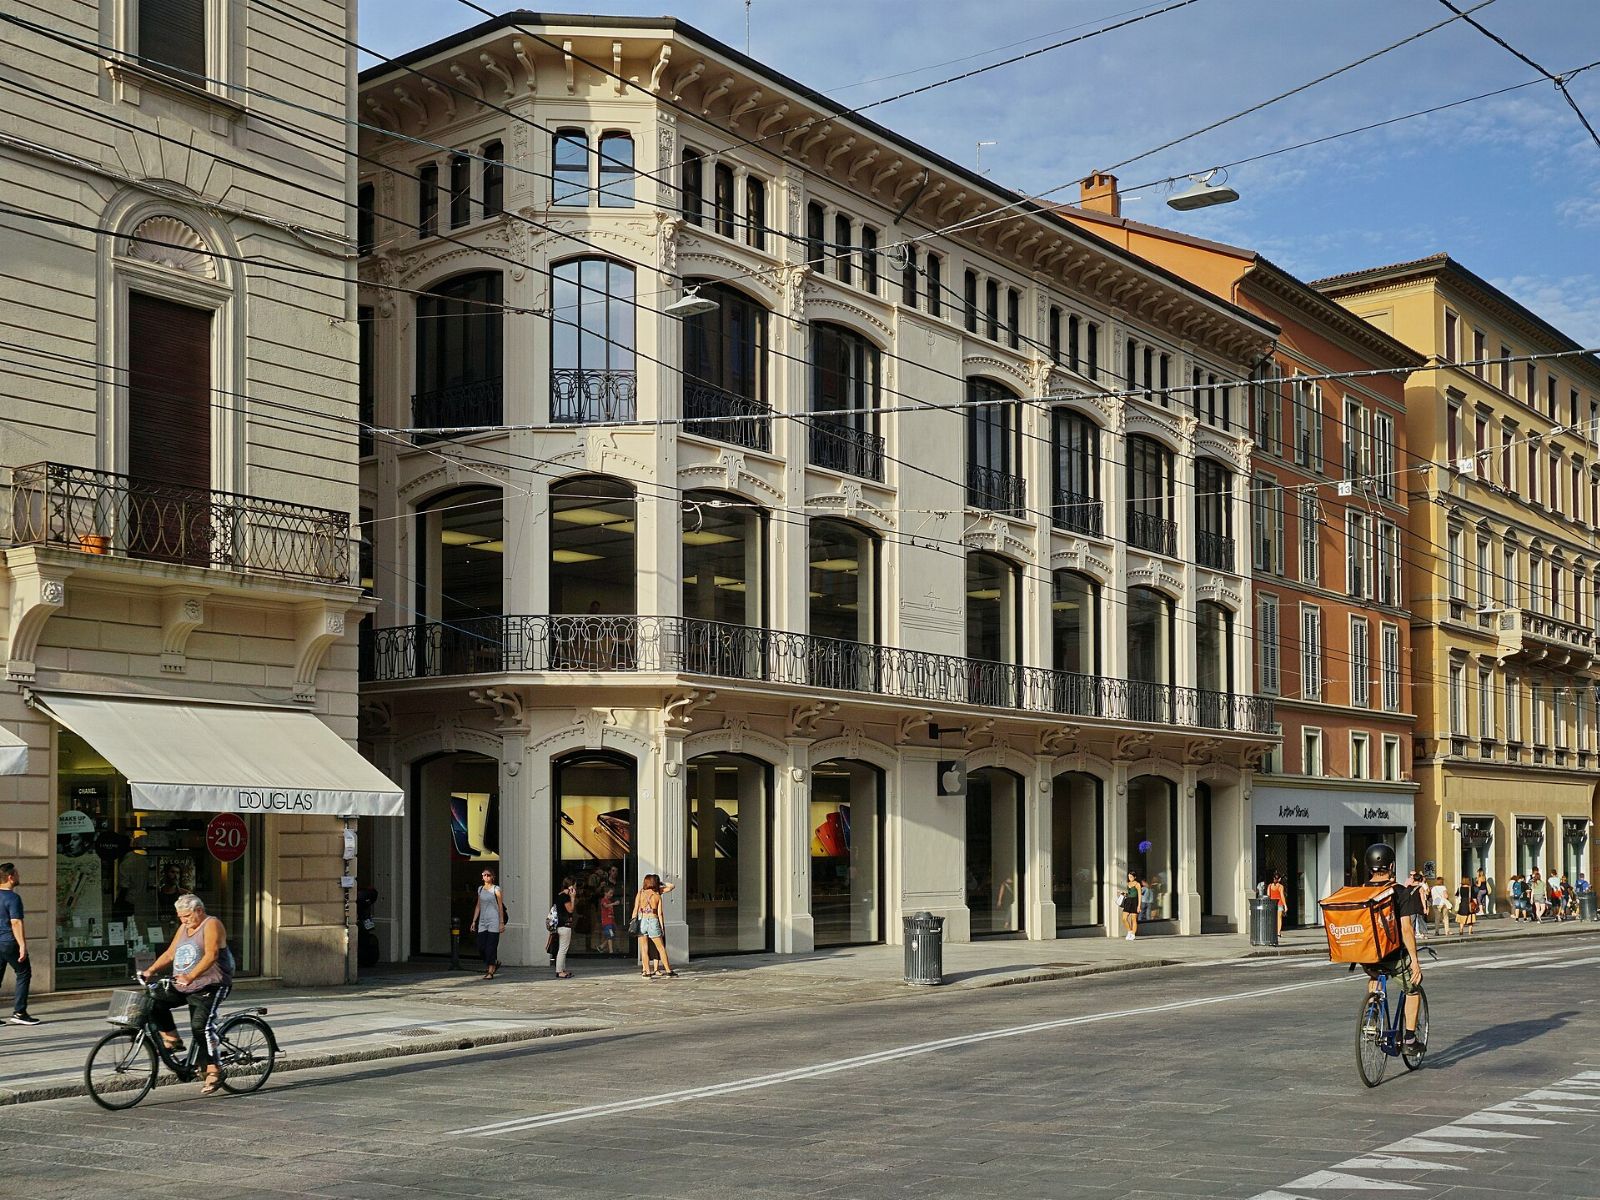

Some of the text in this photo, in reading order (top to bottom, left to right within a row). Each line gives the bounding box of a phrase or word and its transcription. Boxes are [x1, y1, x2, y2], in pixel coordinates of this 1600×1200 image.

[1339, 485, 1351, 495] 13
[238, 791, 313, 811] DOUGLAS
[57, 949, 110, 964] DOUGLAS
